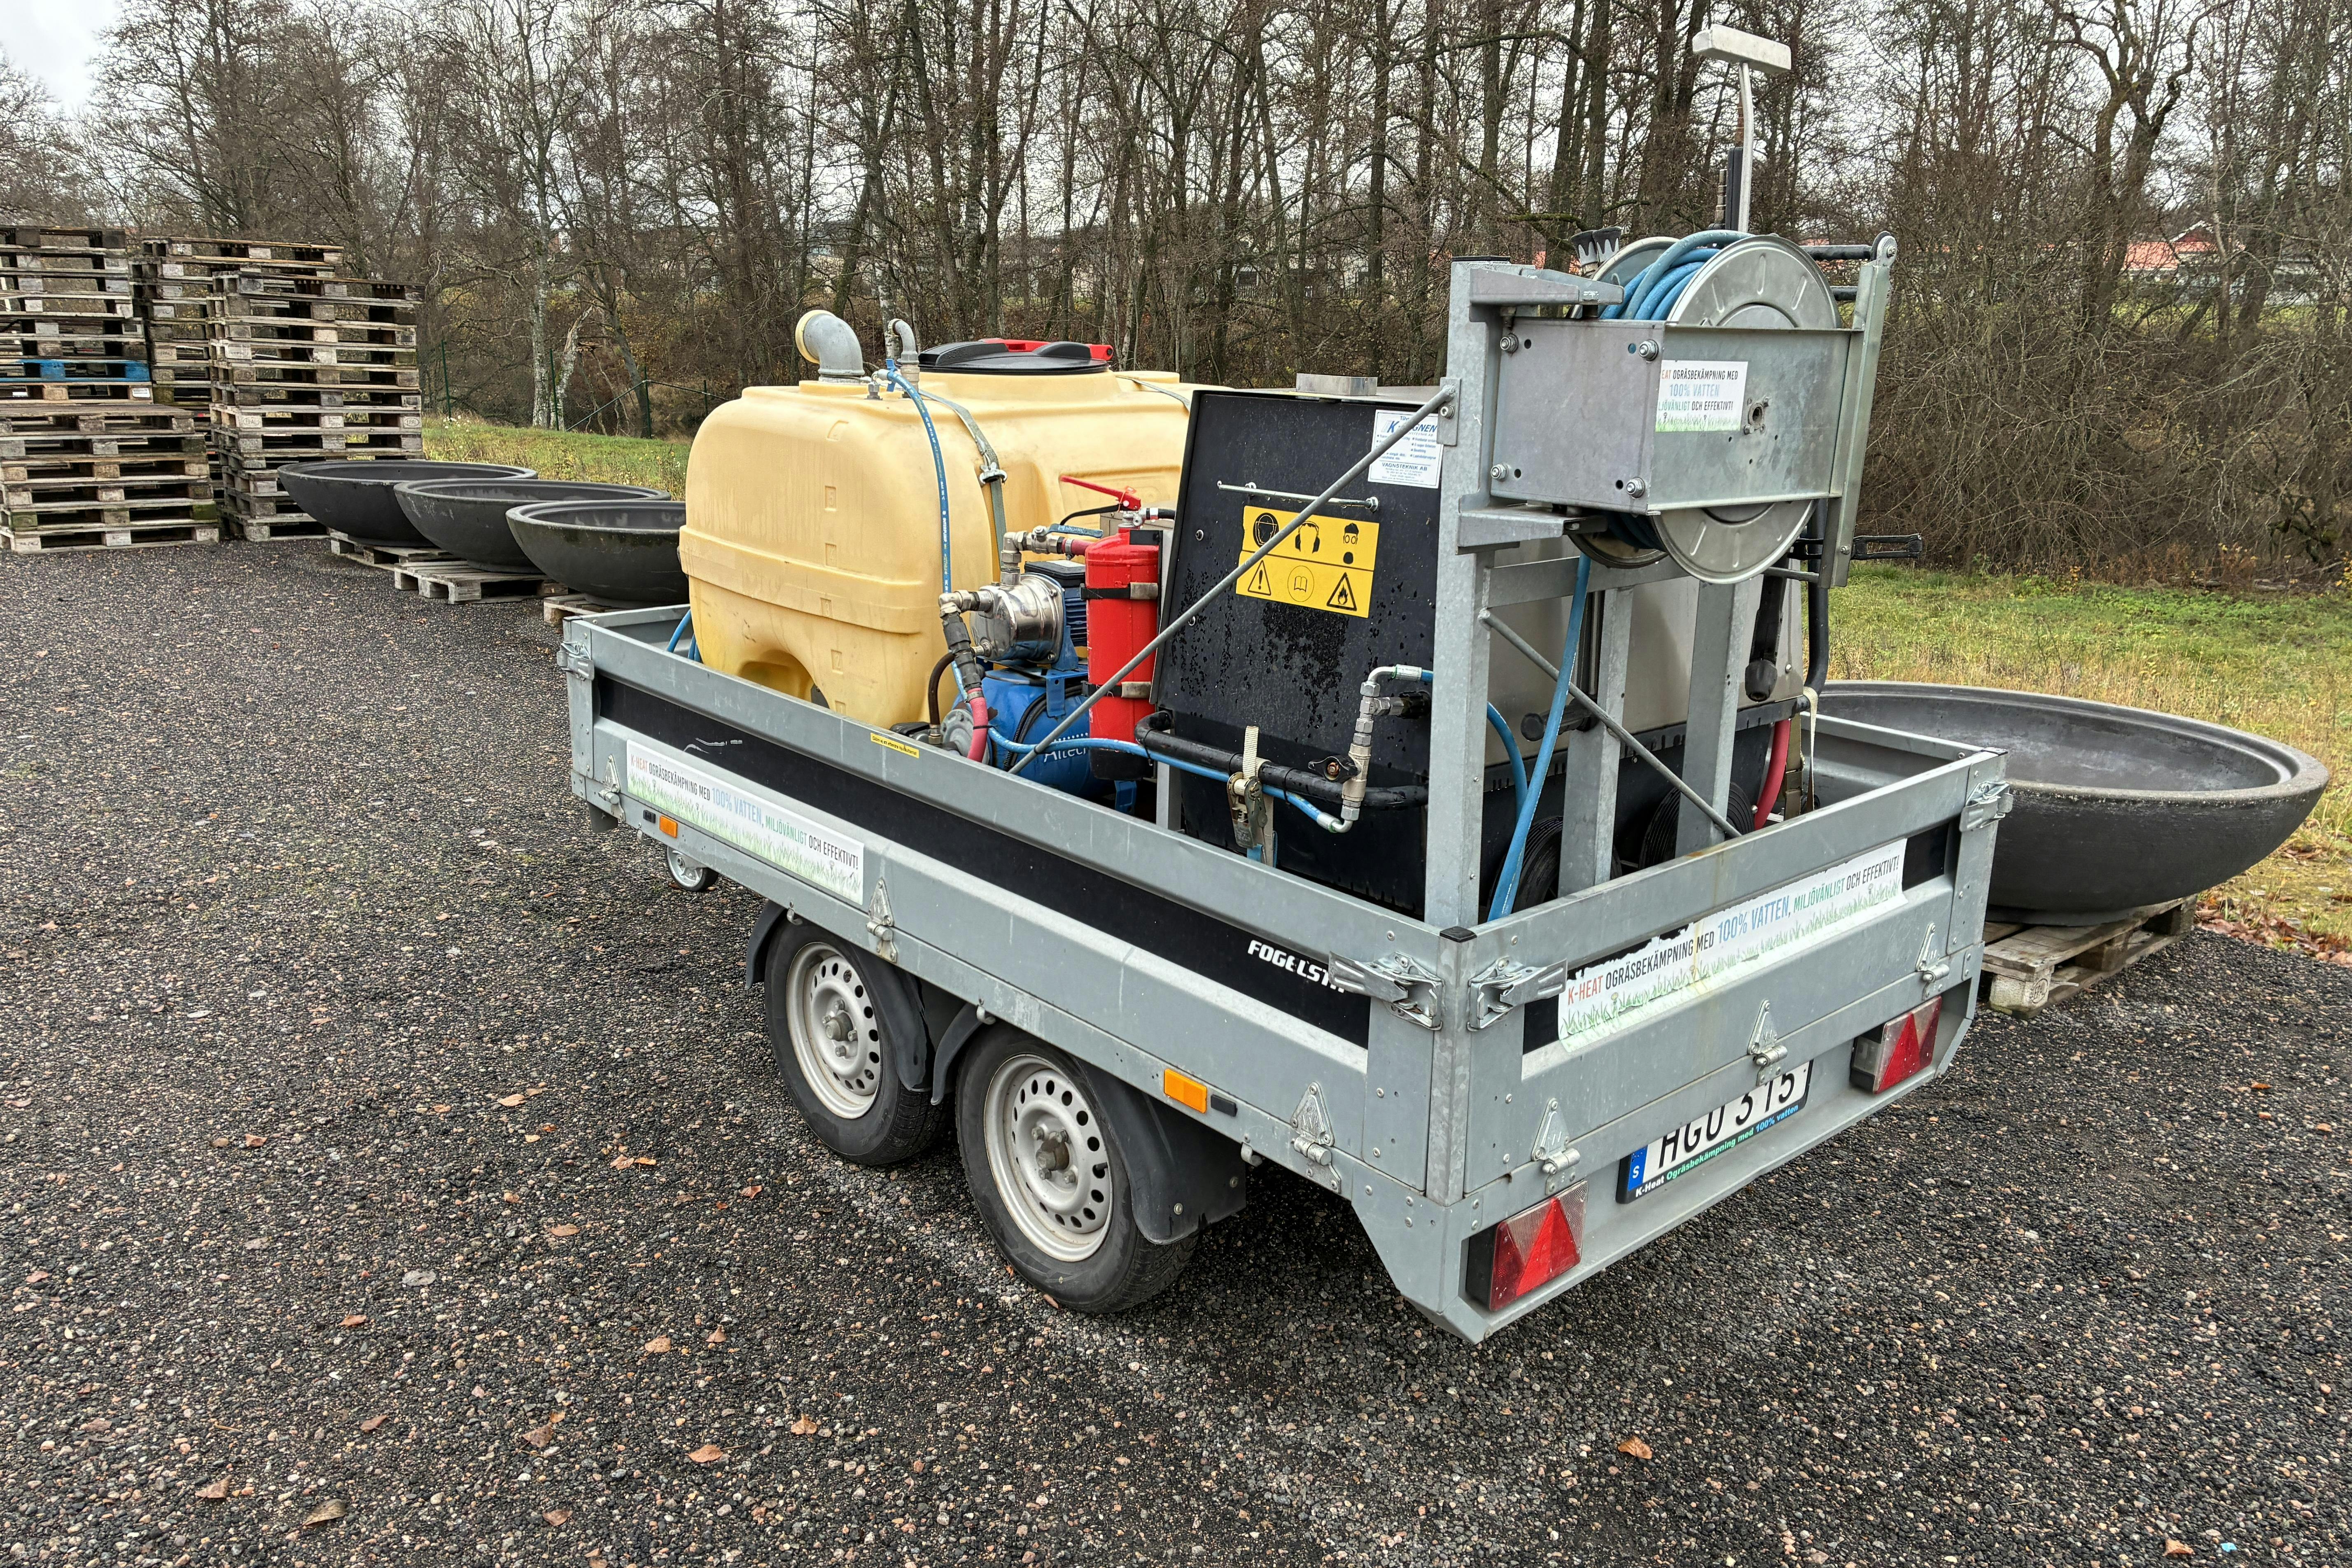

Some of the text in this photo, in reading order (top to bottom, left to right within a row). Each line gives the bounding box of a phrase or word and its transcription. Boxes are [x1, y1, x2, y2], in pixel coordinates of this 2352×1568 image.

[1670, 384, 1720, 397] 100% VATTEN
[1673, 369, 1725, 380] OGRÄSBEKÄMPNING
[1727, 371, 1738, 380] MED
[1692, 401, 1702, 411] OCH
[1704, 401, 1733, 411] EFFEKTIVT!
[631, 754, 858, 870] K-HEAT OGRÄSBEKÄMPNING MED 100% VATTEN, MILJÖVÄNLIGT OCH EFFEKTIVT!
[1568, 855, 1899, 1005] K-HEAT OGRÄSBEKÄMPNING MED 100% VATTEN, MILJÖVÄNLIGT OCH EFFEKTIVT!
[1248, 940, 1344, 993] FOGELST
[1636, 1105, 1798, 1197] K-Heat Ogräsbekämpning med 100% vatten
[1632, 1165, 1639, 1178] S
